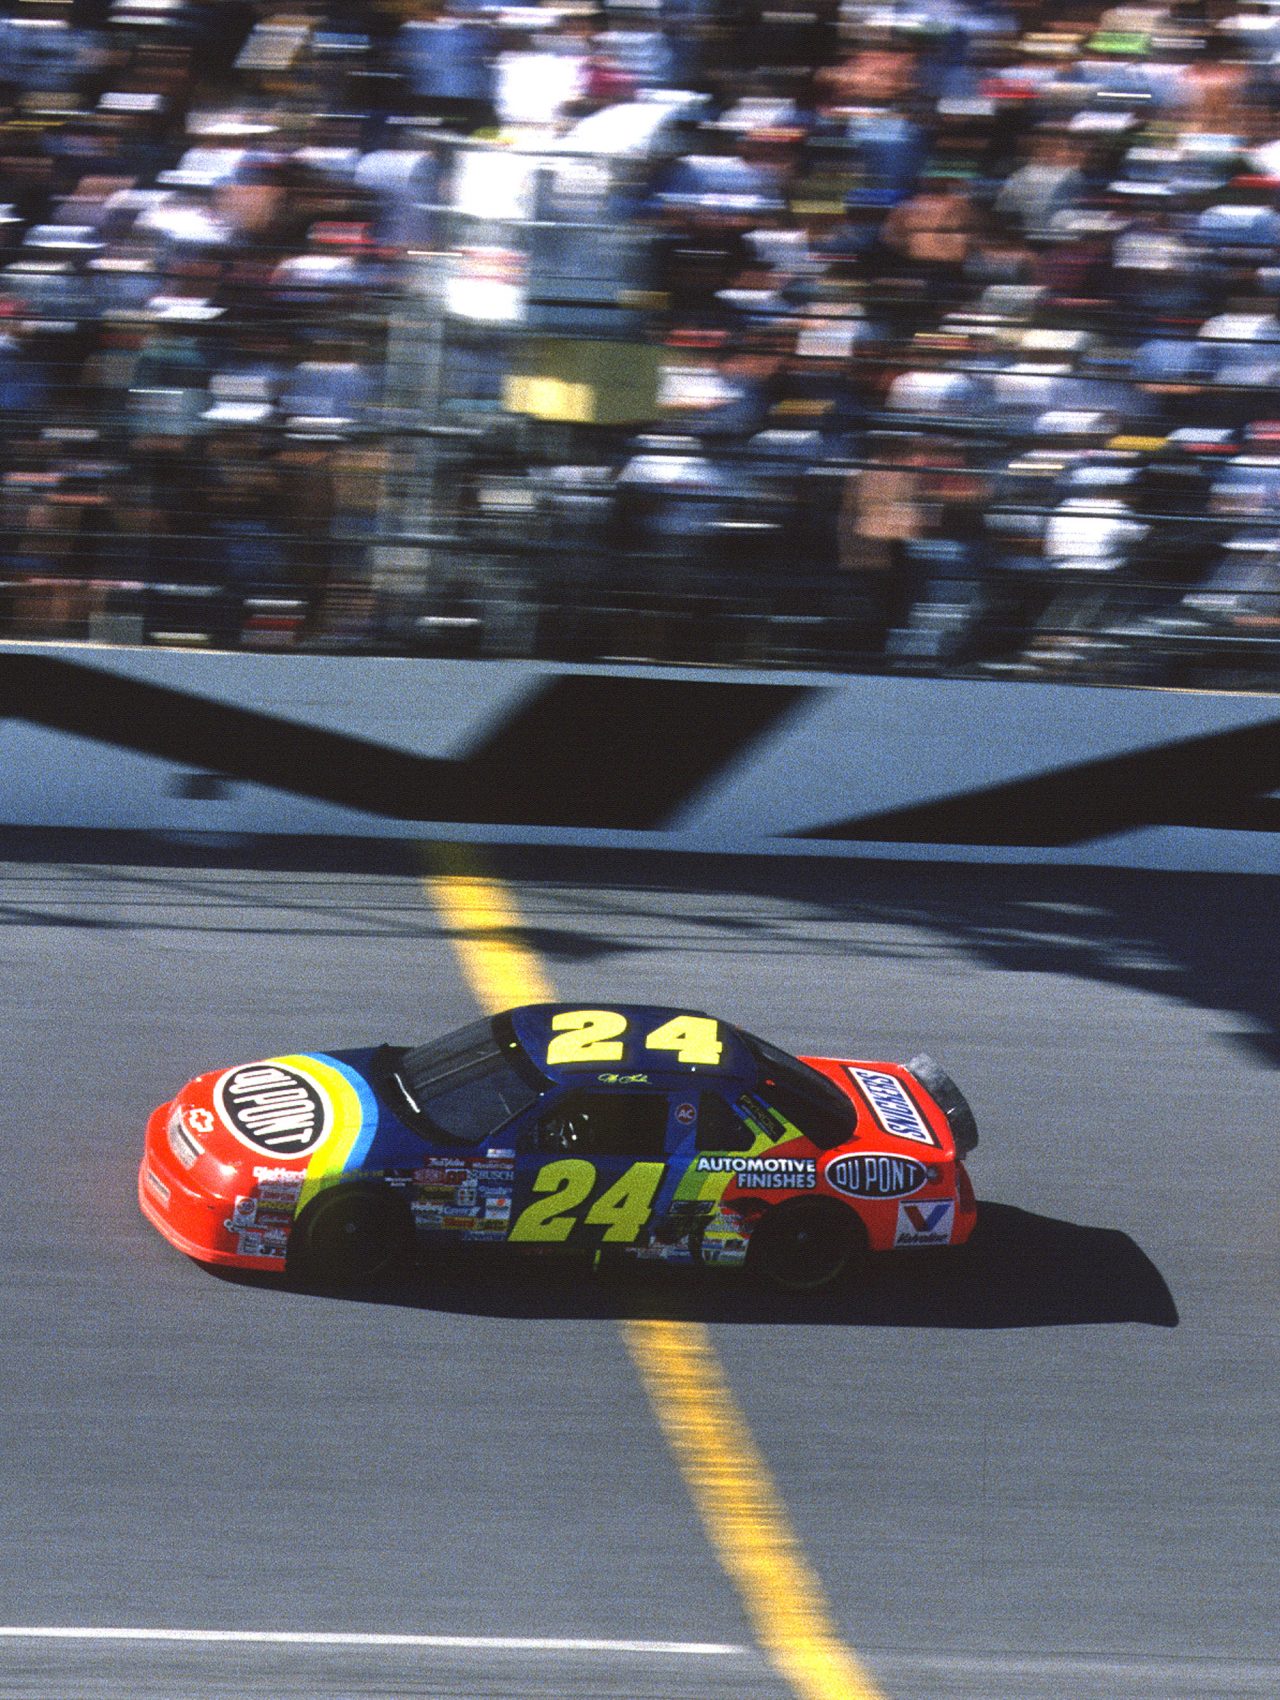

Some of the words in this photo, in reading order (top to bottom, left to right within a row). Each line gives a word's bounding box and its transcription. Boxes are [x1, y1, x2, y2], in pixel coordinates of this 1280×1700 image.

[547, 1010, 723, 1065] 24
[233, 1087, 315, 1146] PONT
[856, 1071, 926, 1140] SNICKERS
[697, 1157, 816, 1173] AUTOMOTIVE
[737, 1173, 816, 1189] FINISHES
[836, 1160, 860, 1190] DU
[864, 1158, 917, 1192] PONT
[508, 1158, 667, 1242] 24
